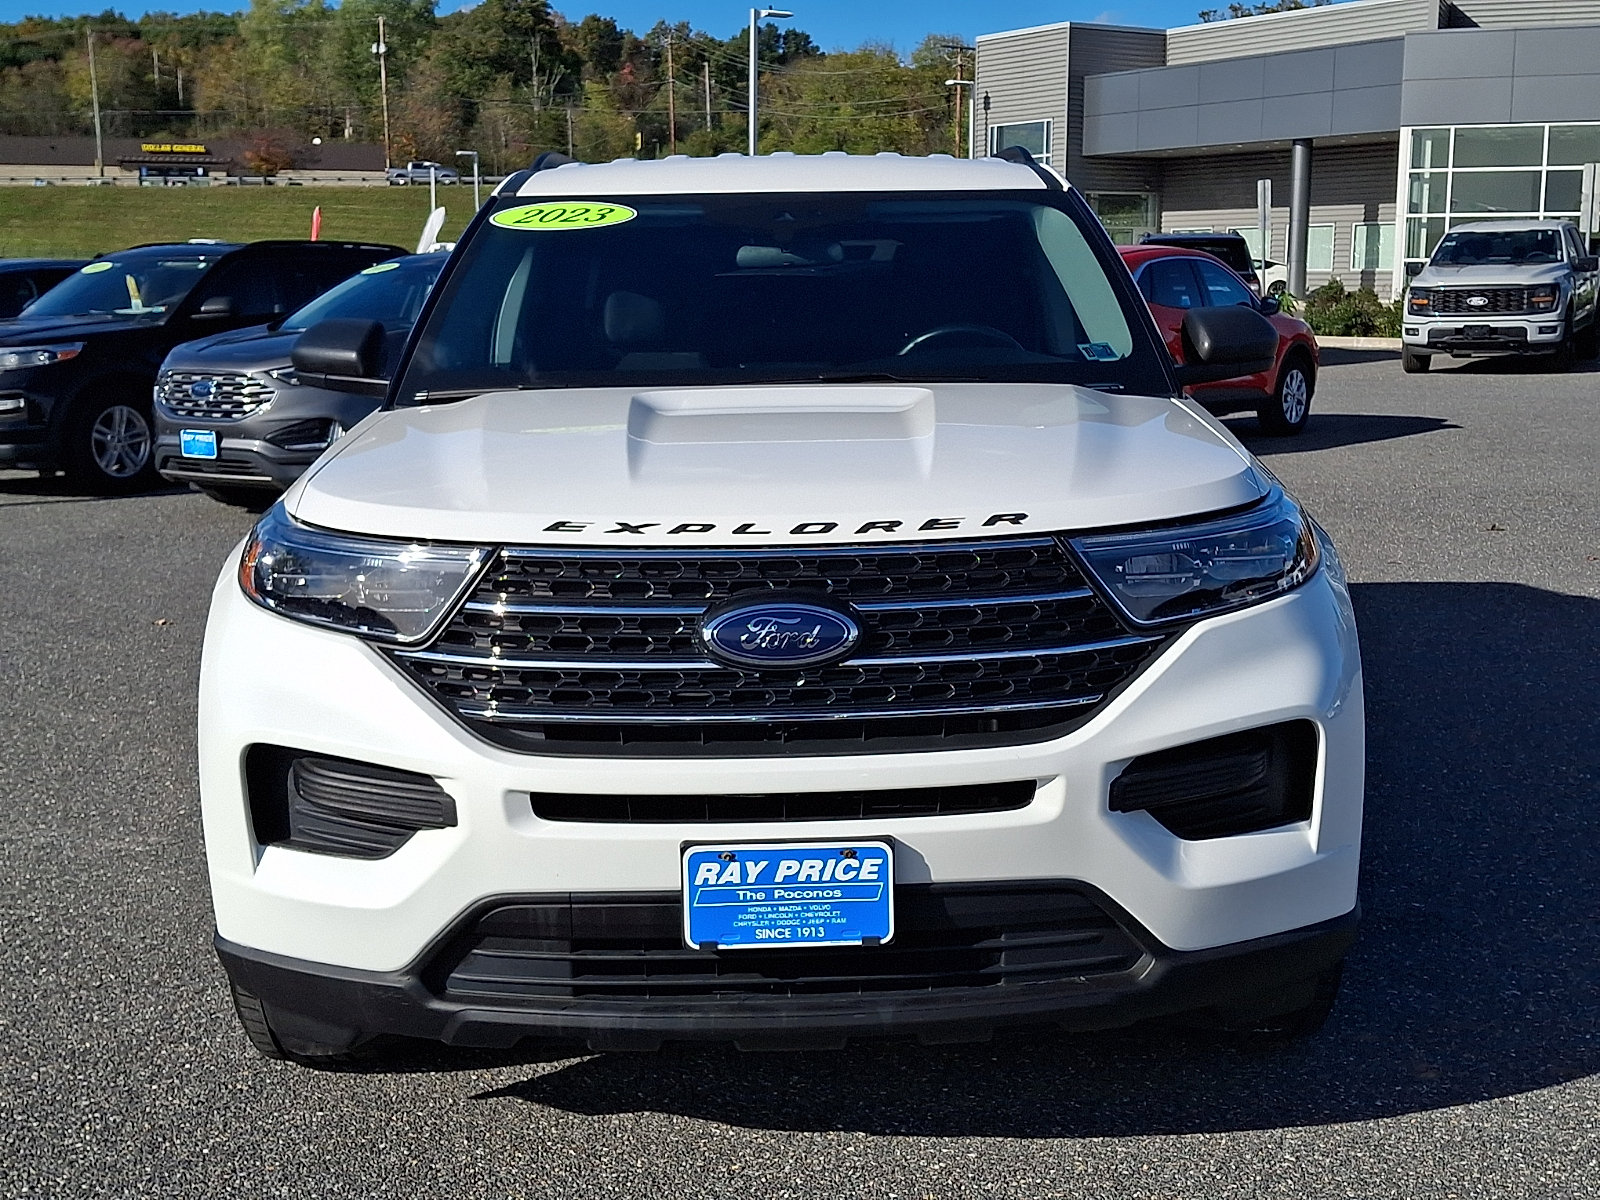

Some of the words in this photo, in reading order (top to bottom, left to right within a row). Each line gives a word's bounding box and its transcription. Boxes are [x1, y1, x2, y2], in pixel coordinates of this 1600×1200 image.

[512, 207, 616, 224] 2023
[542, 511, 1030, 536] EXPLORER
[740, 616, 822, 652] Ford
[694, 860, 769, 886] RAY
[774, 857, 884, 883] PRICE
[736, 890, 766, 901] The
[774, 888, 843, 899] Poconos
[800, 910, 841, 918] CHEVROLET
[755, 928, 792, 939] SINCE
[796, 926, 825, 938] 1913
